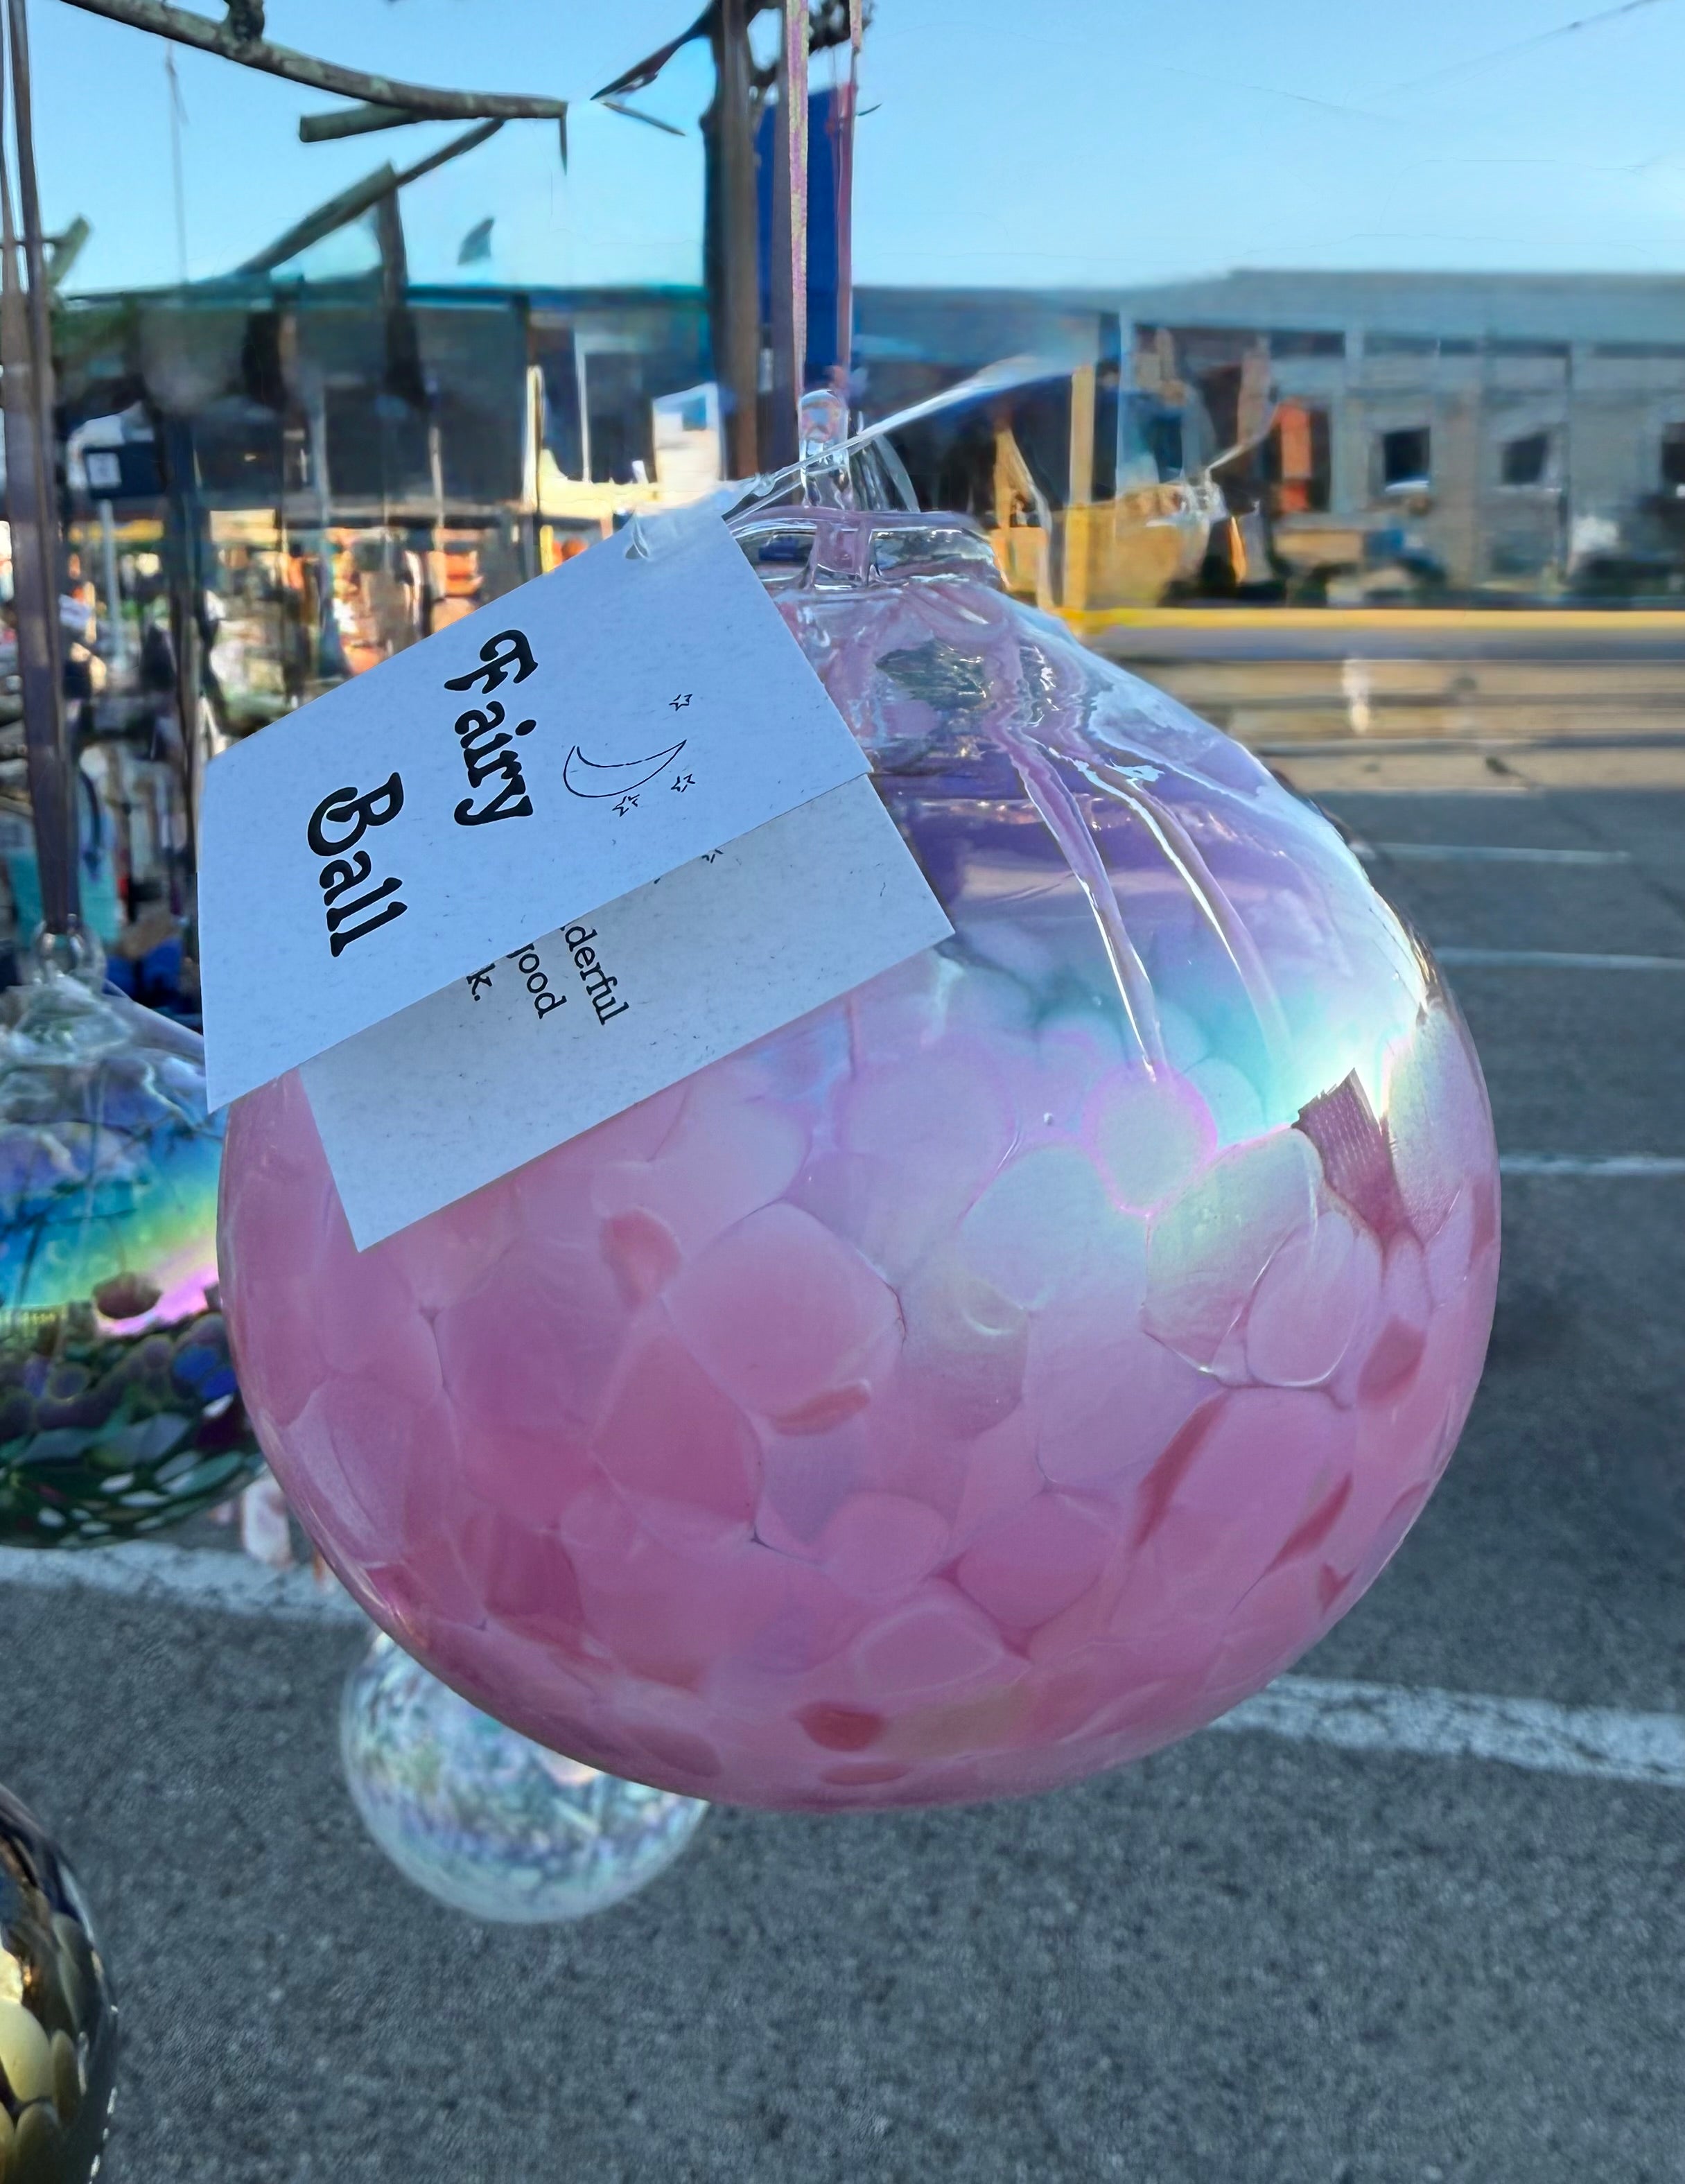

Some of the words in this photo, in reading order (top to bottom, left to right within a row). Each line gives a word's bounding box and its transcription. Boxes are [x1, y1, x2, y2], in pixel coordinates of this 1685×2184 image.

[444, 629, 539, 826] Fairy
[307, 771, 408, 958] Ball
[560, 925, 630, 1026] derful
